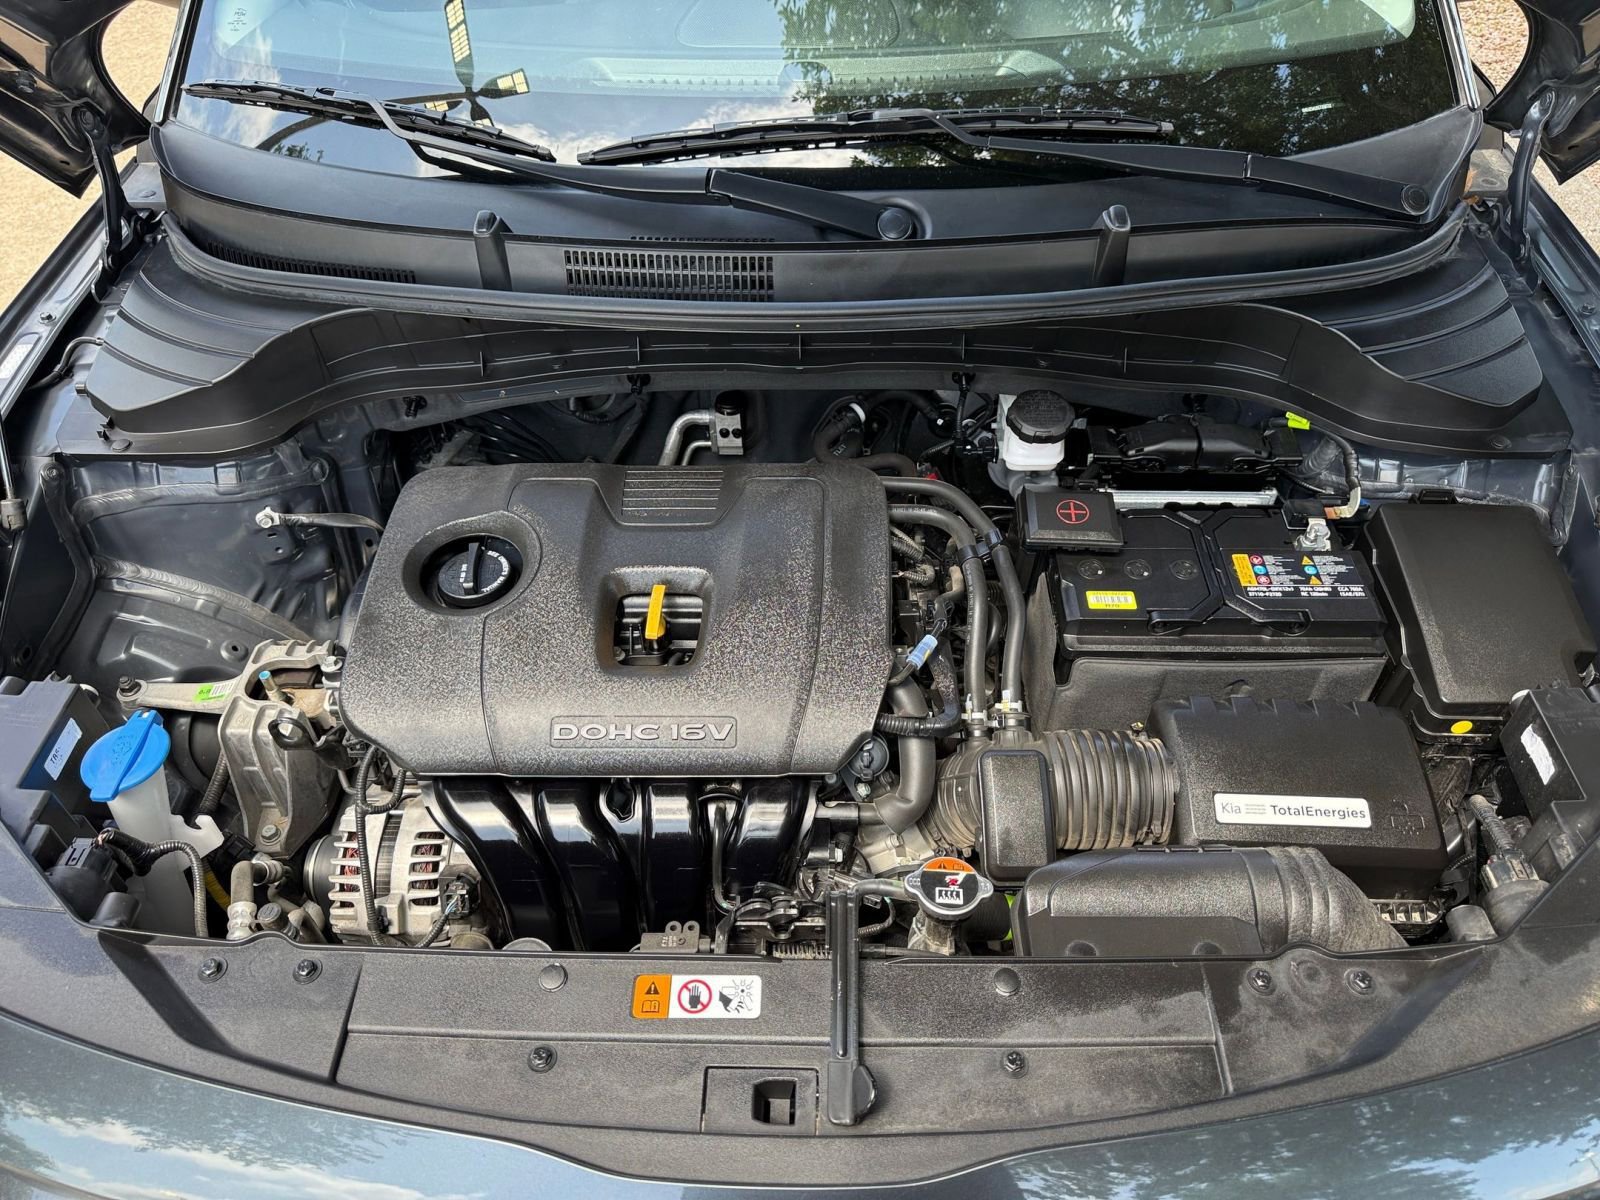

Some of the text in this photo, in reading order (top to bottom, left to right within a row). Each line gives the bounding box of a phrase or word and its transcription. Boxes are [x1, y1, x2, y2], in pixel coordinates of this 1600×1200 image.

[553, 723, 734, 741] DOHC 16V
[1221, 802, 1242, 814] Kia
[1270, 804, 1366, 820] TotalEnergies
